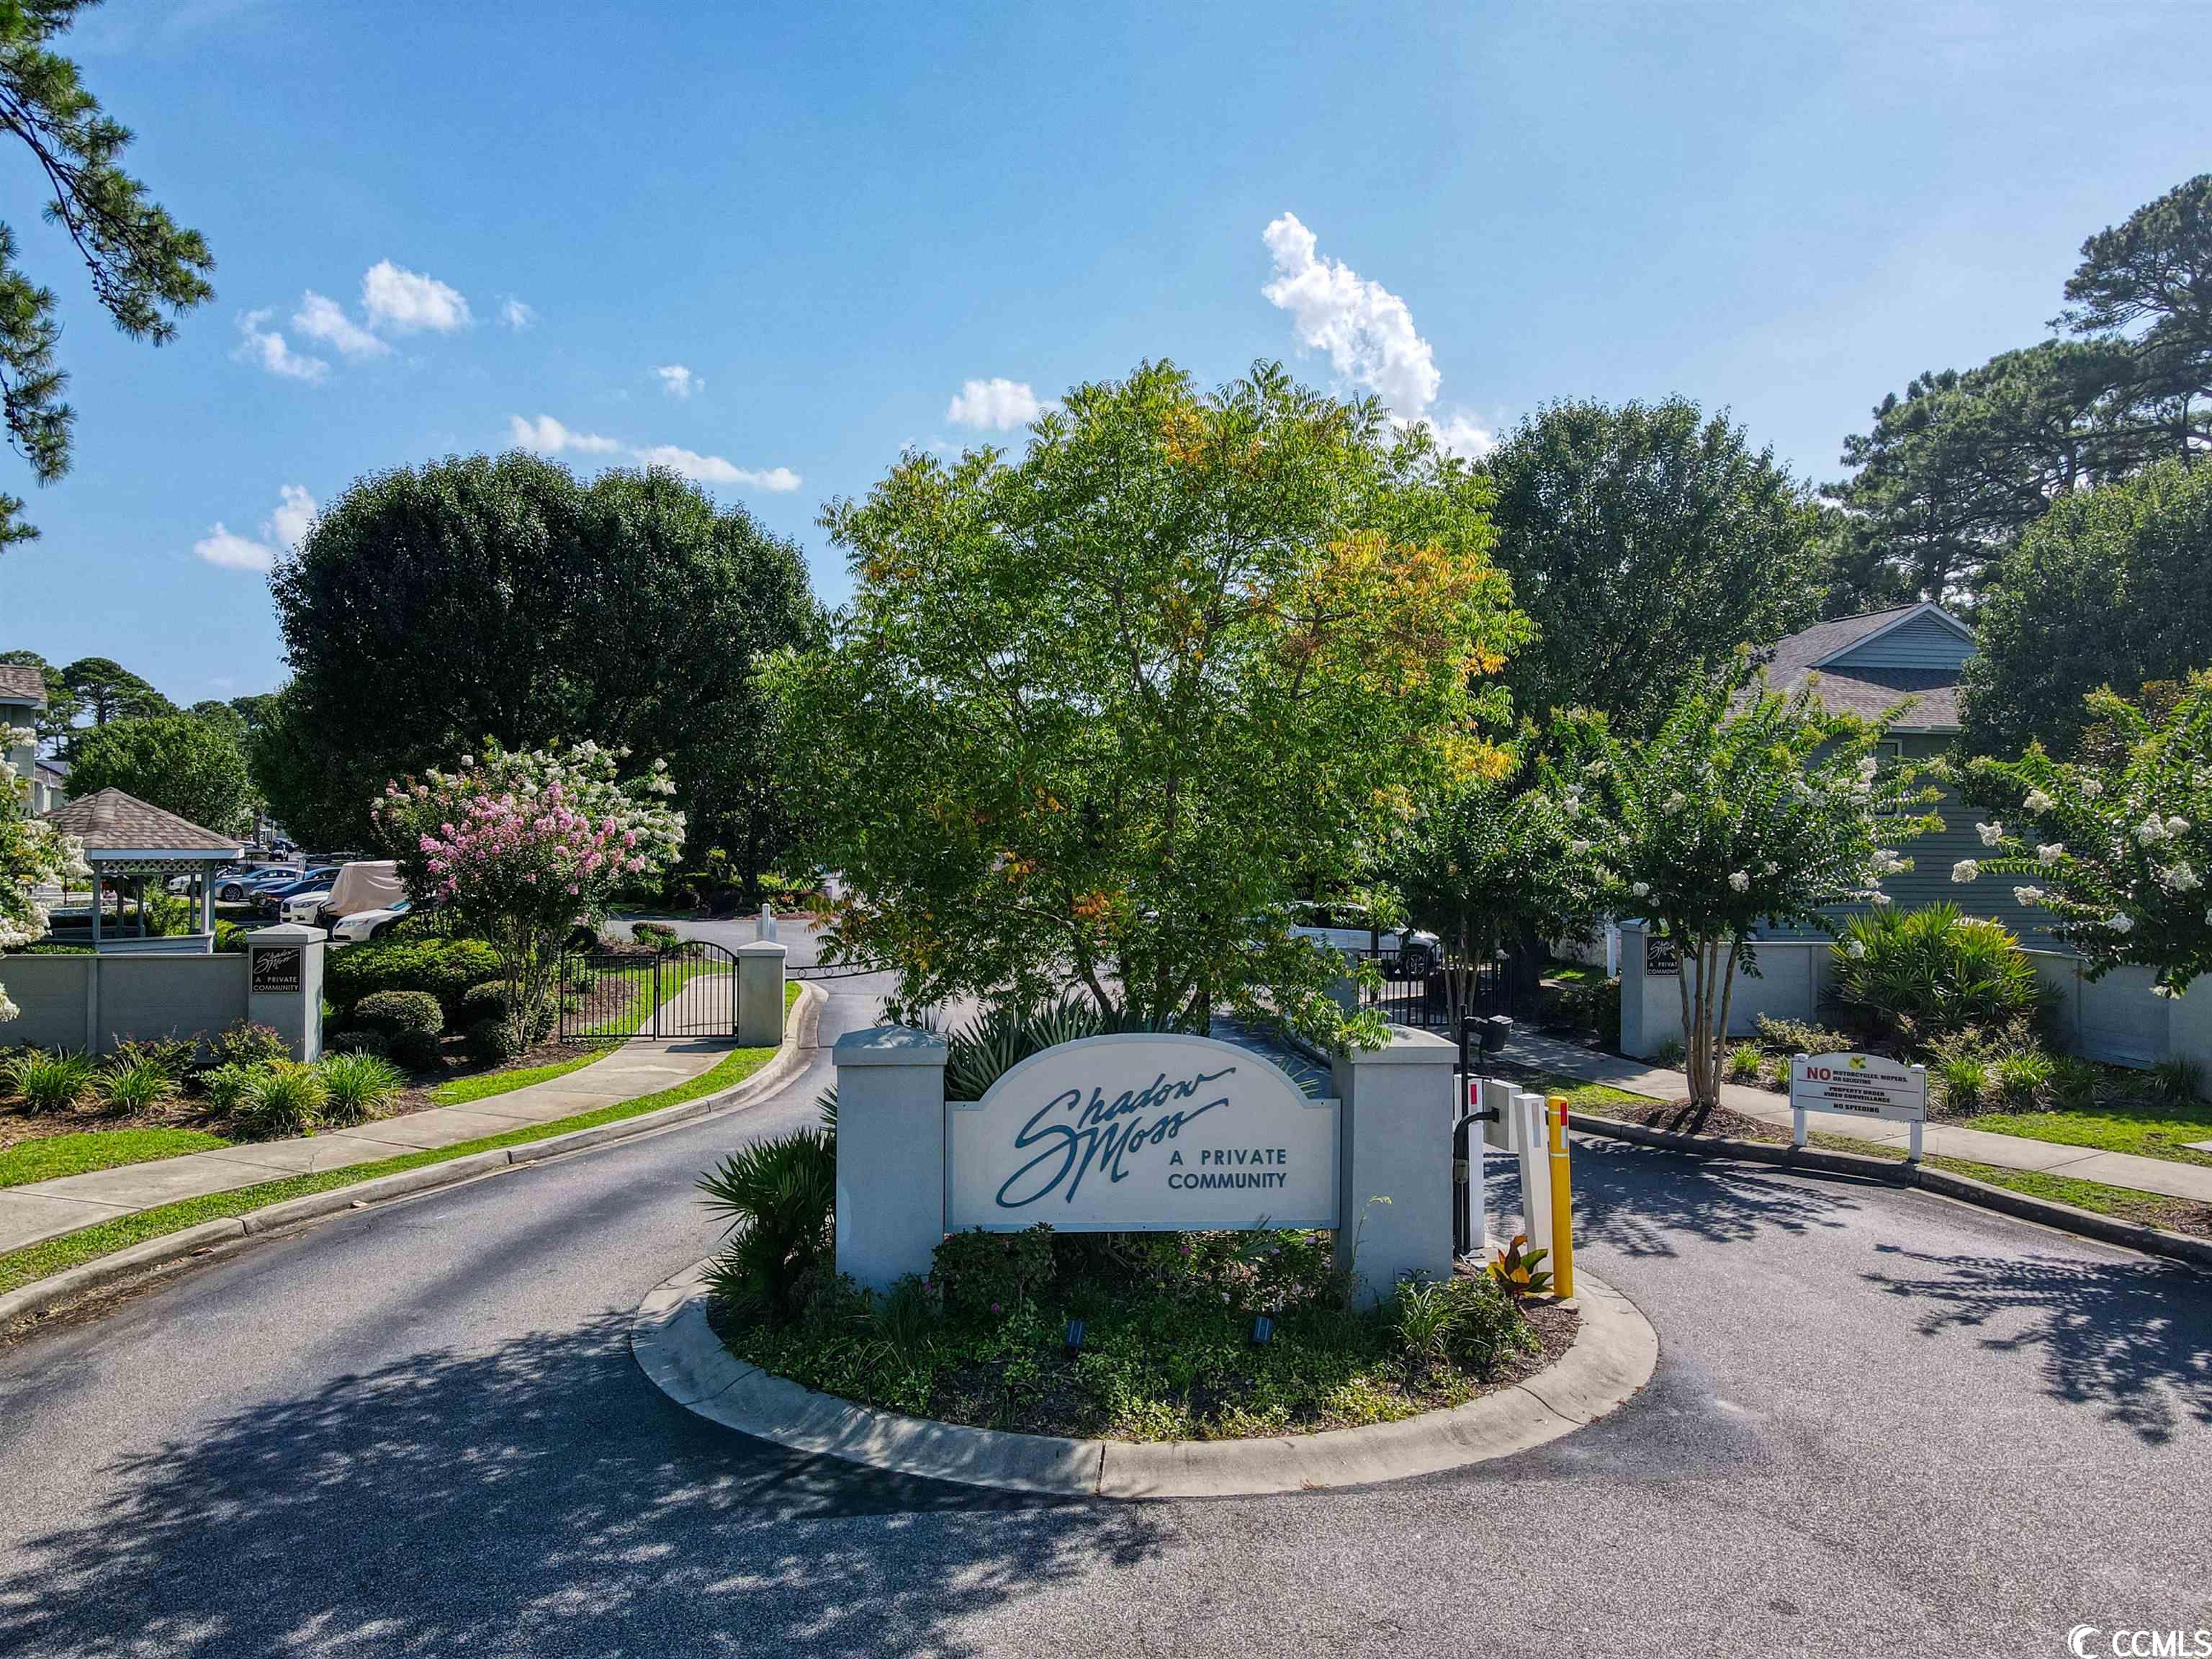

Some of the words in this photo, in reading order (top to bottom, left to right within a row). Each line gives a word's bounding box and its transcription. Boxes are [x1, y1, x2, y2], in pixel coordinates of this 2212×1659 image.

[1807, 1066, 1832, 1080] NO
[1844, 1094, 1890, 1102] SURVEILLANCE
[1845, 1105, 1879, 1113] SPEEDING
[996, 1067, 1236, 1208] Shadow
[1066, 1099, 1228, 1203] Moss
[1169, 1150, 1183, 1166] A
[1202, 1149, 1287, 1165] PRIVATE
[1168, 1172, 1287, 1190] COMMUNITY
